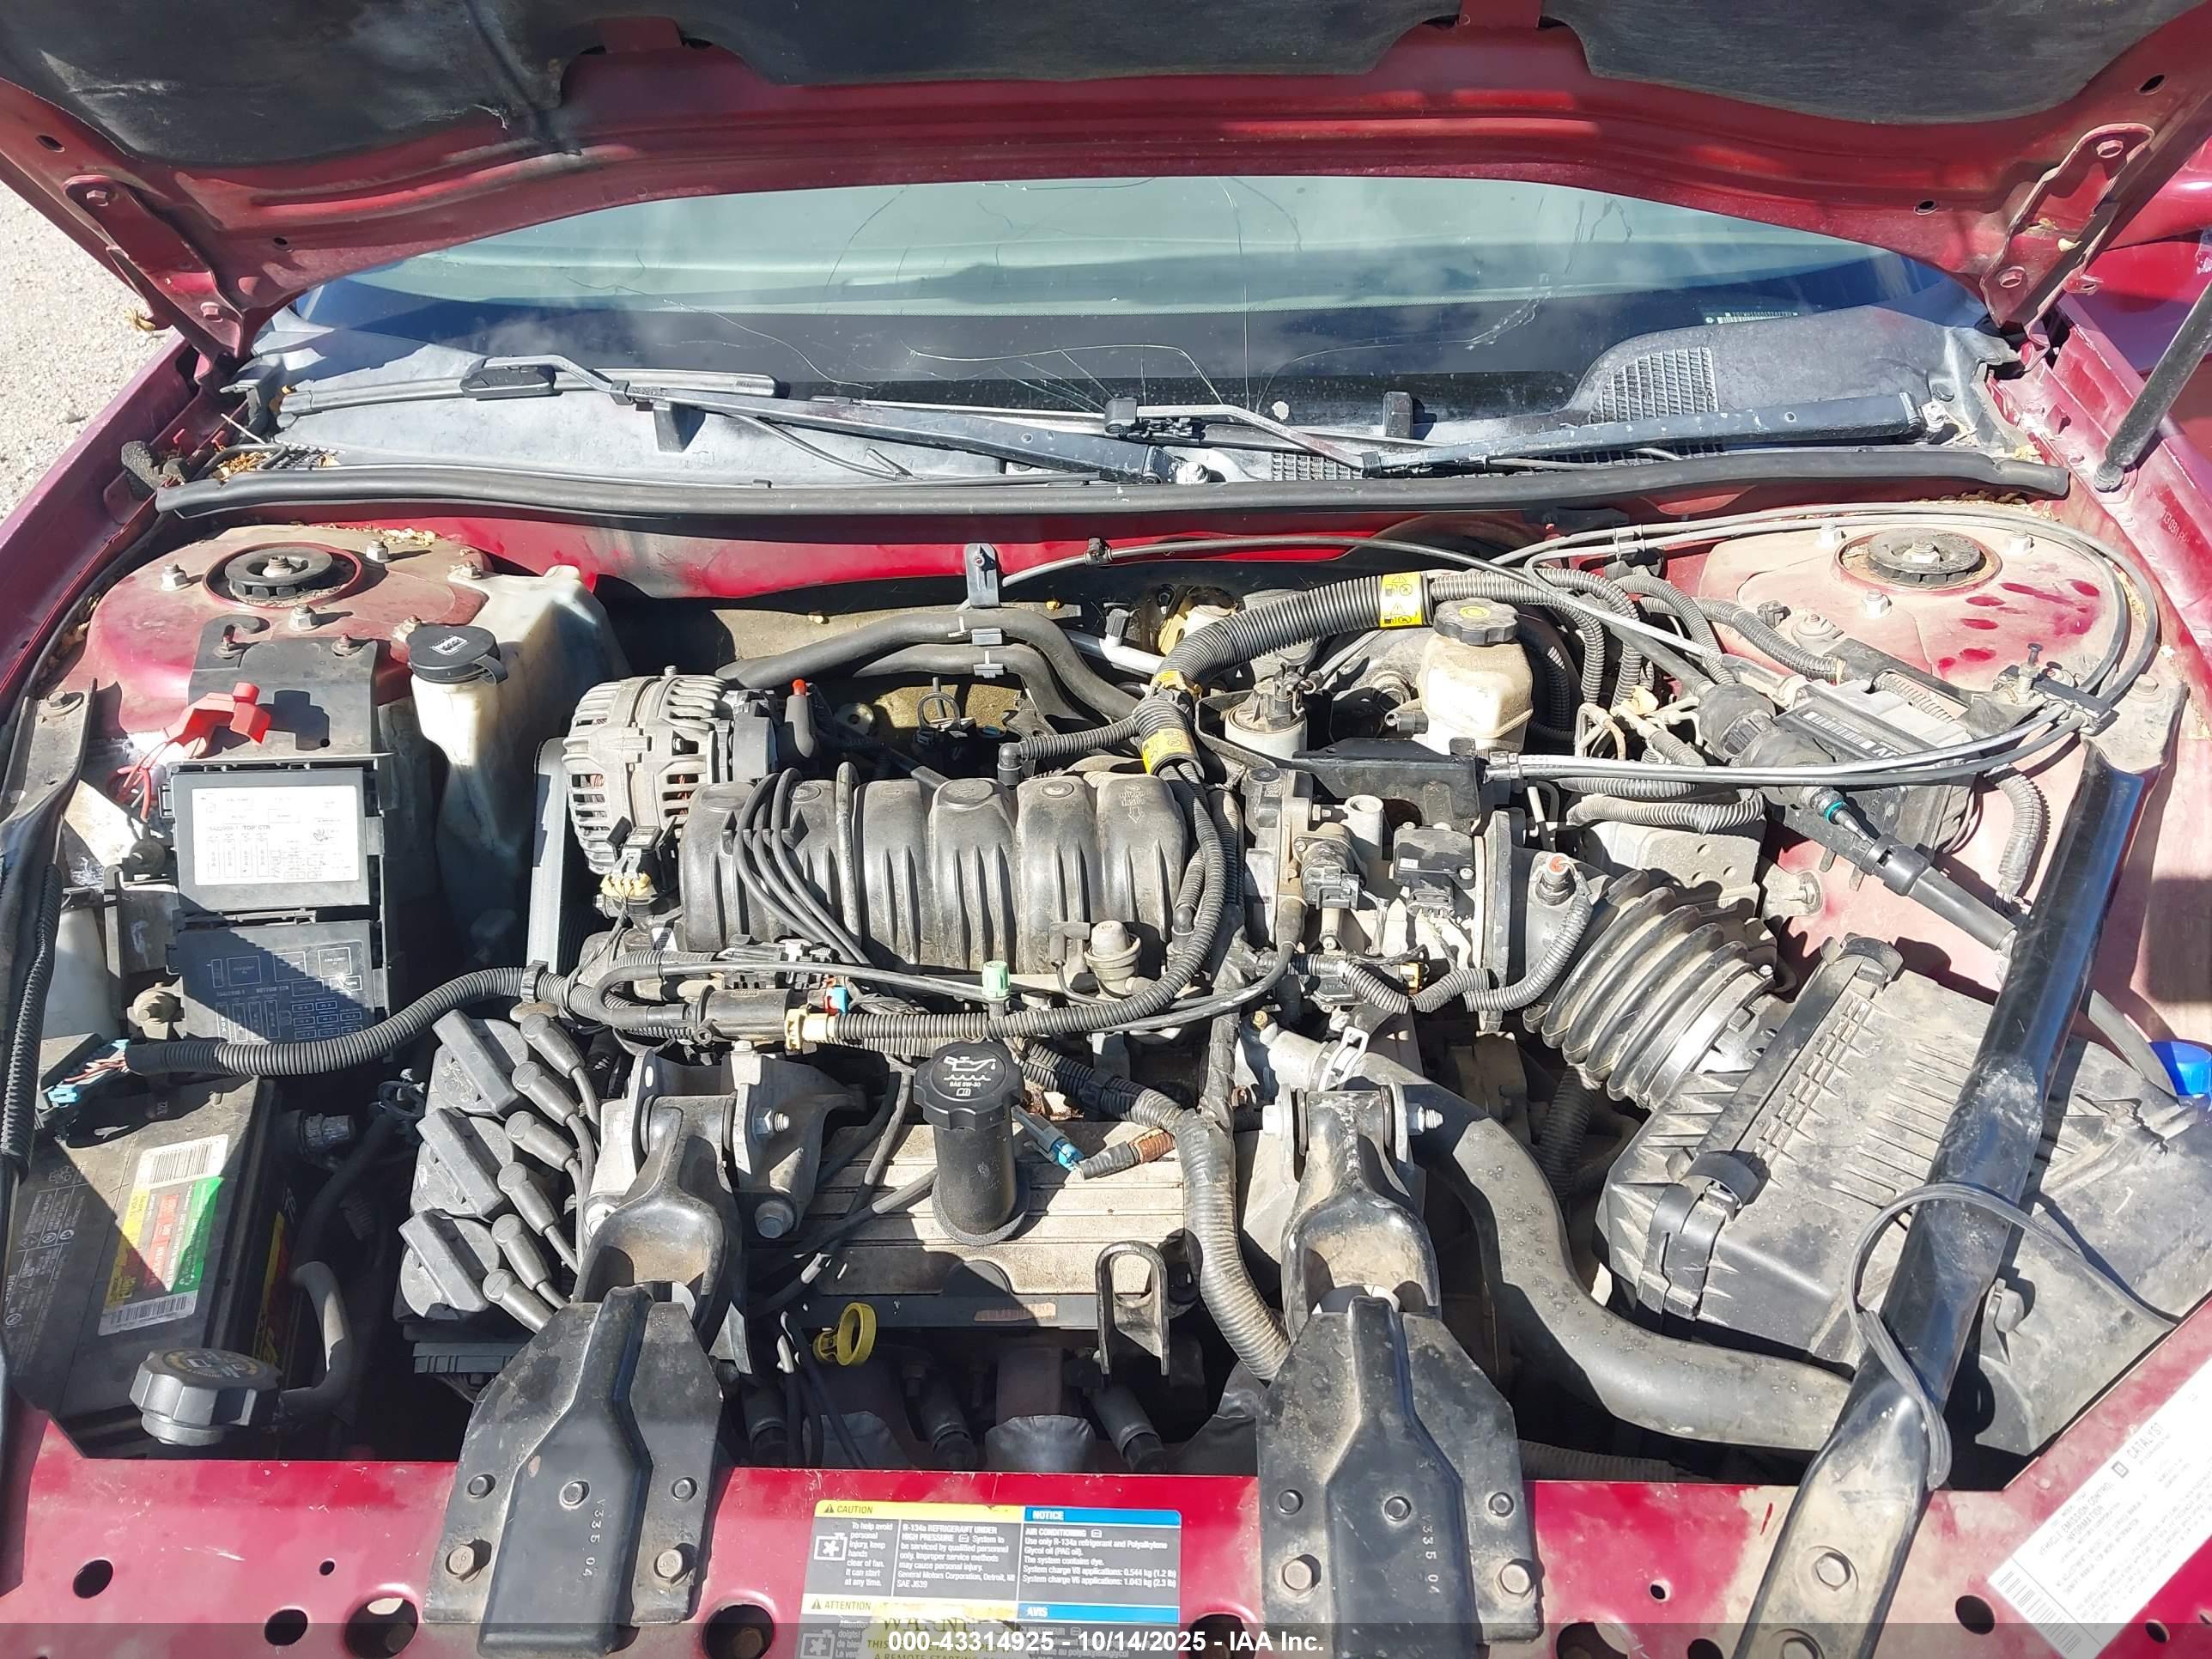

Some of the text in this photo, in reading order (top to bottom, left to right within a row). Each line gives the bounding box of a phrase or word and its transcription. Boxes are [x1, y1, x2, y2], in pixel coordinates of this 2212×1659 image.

[836, 1505, 873, 1514] CAUTION
[1033, 1510, 1064, 1520] NOTICE
[860, 1522, 874, 1531] help
[876, 1522, 893, 1531] avoid
[927, 1525, 973, 1534] REFRIGERANT
[974, 1526, 997, 1534] UNDER
[850, 1532, 878, 1540] personal
[1038, 1528, 1086, 1537] CONDITIONING
[902, 1533, 918, 1541] HIGH
[920, 1534, 953, 1542] PRESSURE
[972, 1535, 995, 1544] System
[870, 1541, 885, 1551] keep
[939, 1544, 946, 1553] by
[948, 1544, 975, 1553] qualified
[976, 1545, 1008, 1554] personnel
[1079, 1540, 1112, 1549] refrigerant
[915, 1553, 945, 1562] Improper
[1037, 1557, 1060, 1565] system
[934, 1563, 962, 1571] personal
[1023, 1565, 1047, 1574] System
[1048, 1566, 1071, 1576] charge
[1144, 1569, 1152, 1578] kg
[1023, 1575, 1047, 1583] System
[1048, 1575, 1071, 1584] charge
[1144, 1578, 1152, 1588] kg
[824, 1601, 871, 1611] ATTENTION
[1027, 1607, 1048, 1617] AVIS
